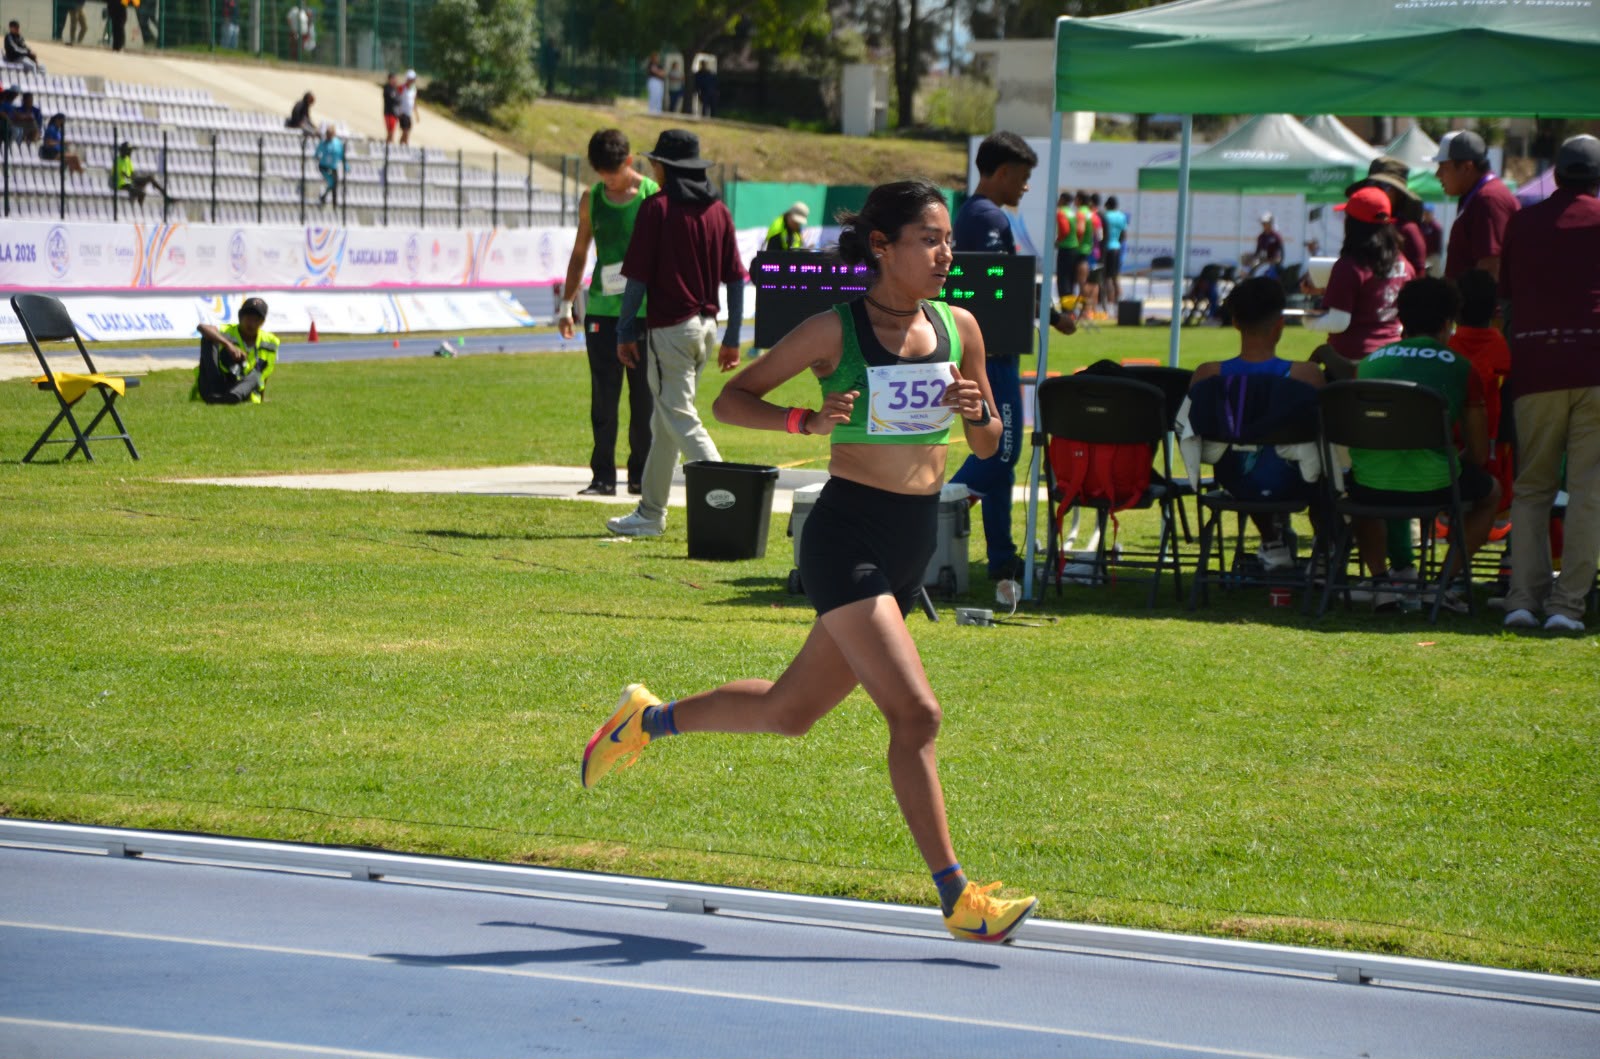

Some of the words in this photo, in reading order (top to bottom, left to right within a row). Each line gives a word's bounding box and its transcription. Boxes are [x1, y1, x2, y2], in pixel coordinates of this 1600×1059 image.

[1394, 1, 1458, 9] CULTURA
[15, 244, 37, 263] 2026
[87, 312, 150, 332] TLAXCALA
[143, 312, 175, 331] 2026
[888, 378, 947, 410] 352
[1002, 403, 1013, 428] RICA
[1000, 430, 1013, 463] COSTA
